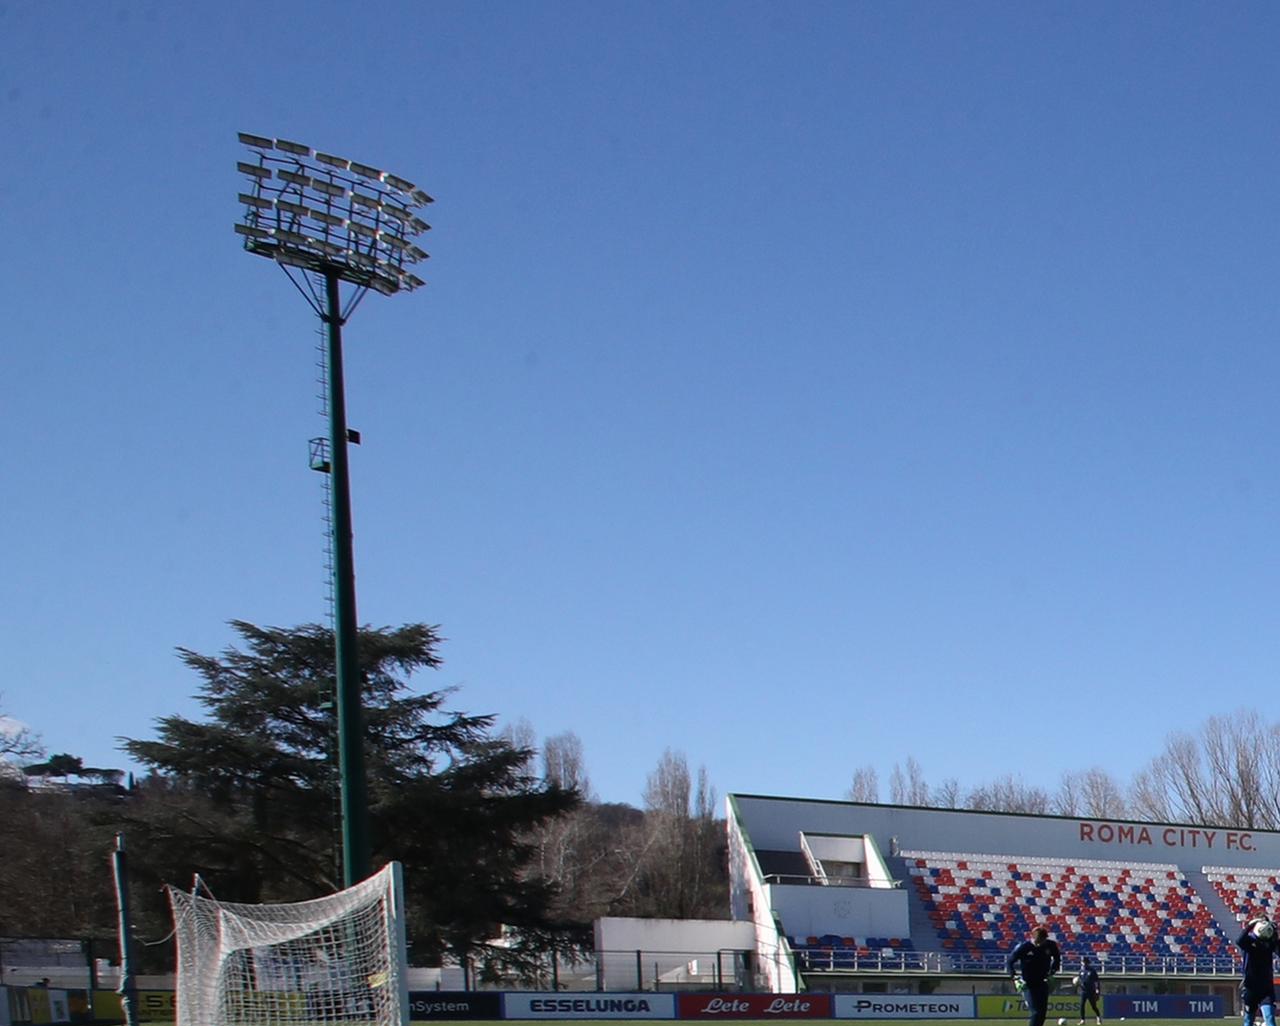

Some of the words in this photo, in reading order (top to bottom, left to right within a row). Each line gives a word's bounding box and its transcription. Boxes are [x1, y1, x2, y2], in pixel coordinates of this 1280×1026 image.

[1080, 823, 1152, 845] ROMA
[1163, 828, 1216, 848] CITY
[1227, 833, 1256, 851] F.C.
[530, 1000, 650, 1012] ESSELUNGA
[701, 998, 749, 1013] Lete
[763, 998, 810, 1013] Lete
[853, 1000, 959, 1013] PROMETEON
[1132, 1001, 1158, 1013] TIM
[1189, 1001, 1214, 1013] TIM
